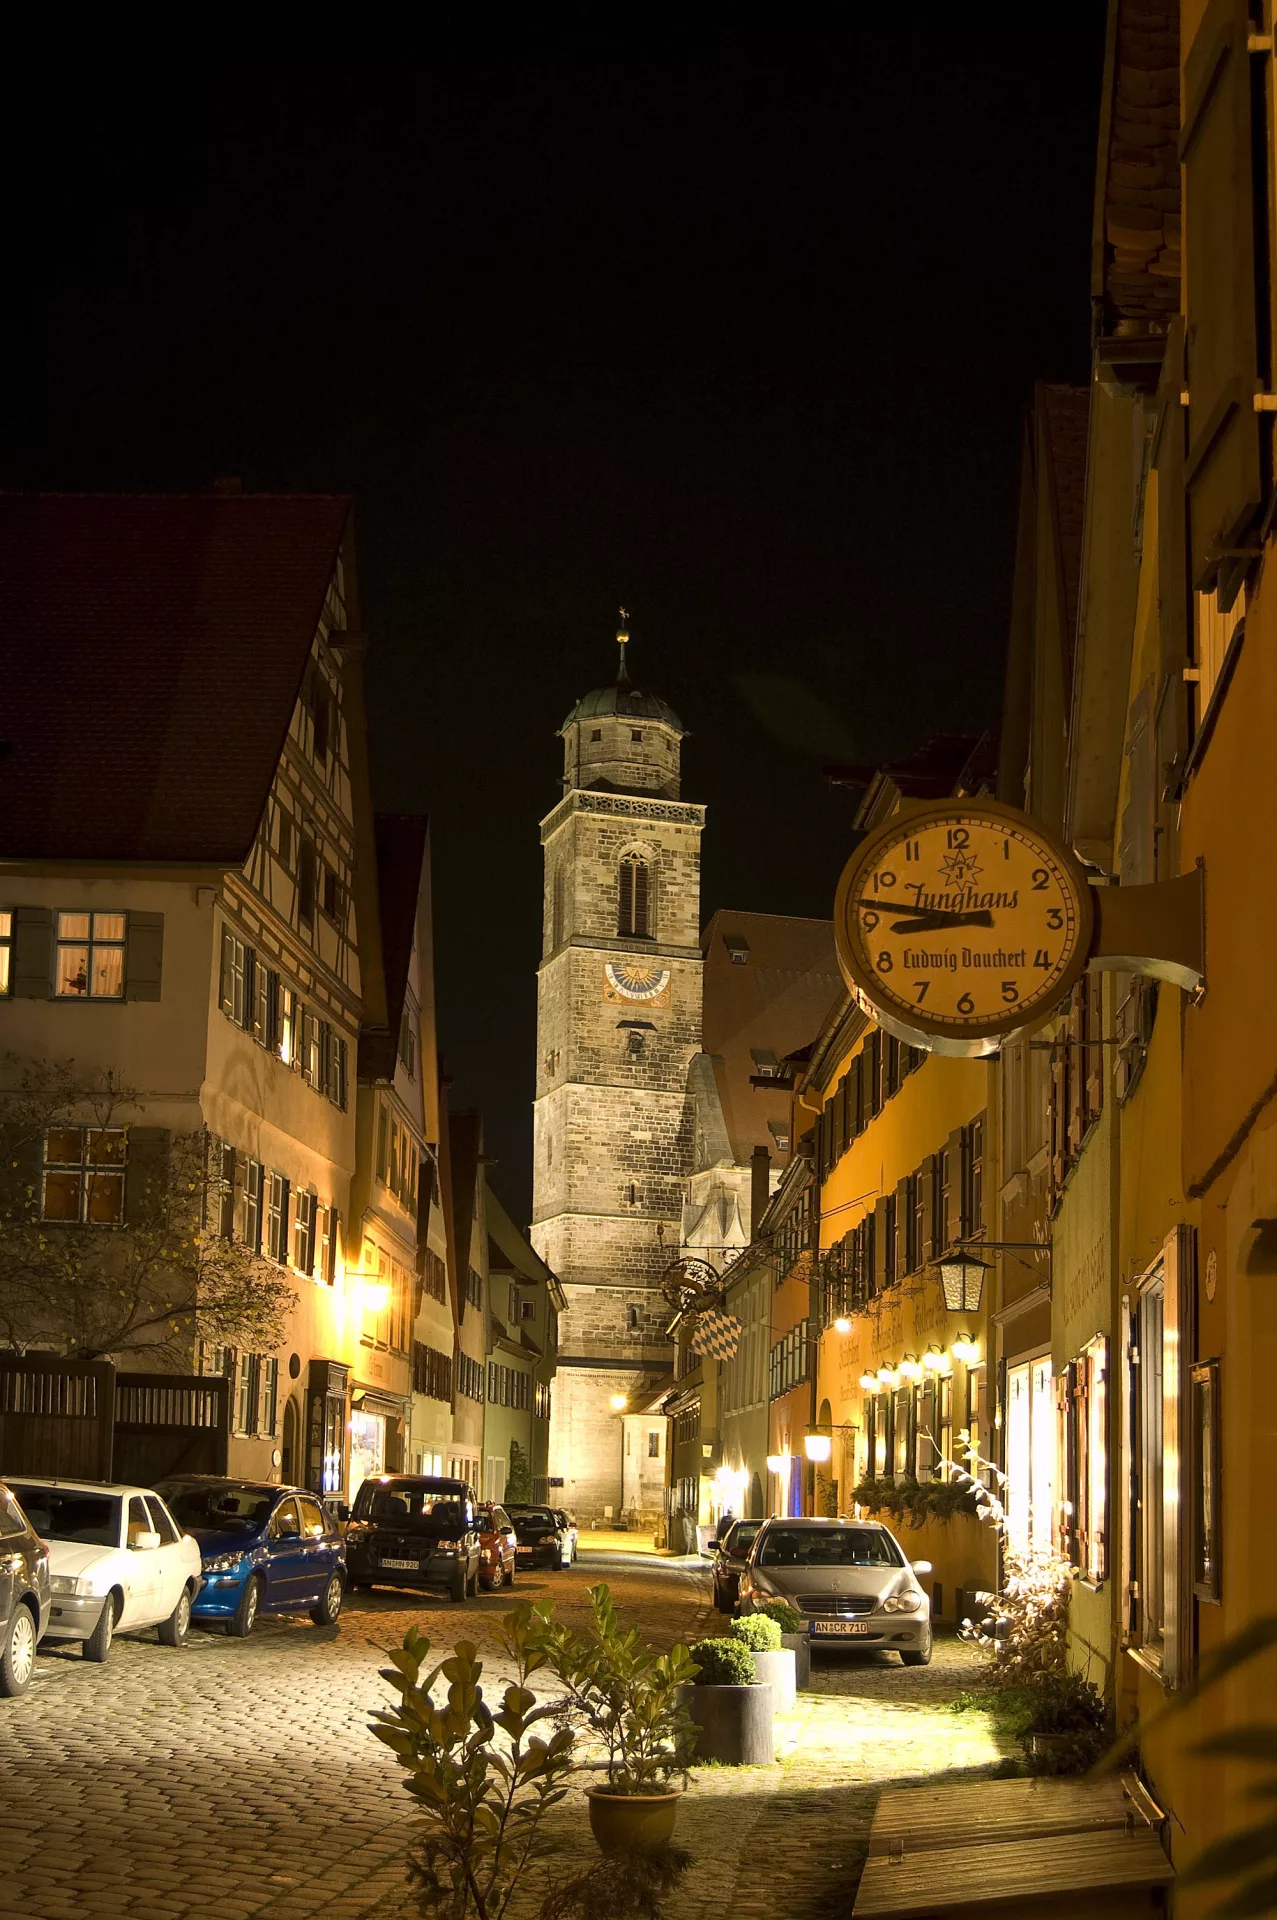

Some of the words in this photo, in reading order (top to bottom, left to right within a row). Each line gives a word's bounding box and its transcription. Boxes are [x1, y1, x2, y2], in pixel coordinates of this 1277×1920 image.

[947, 828, 969, 849] 12
[905, 840, 920, 861] 11
[1004, 839, 1009, 860] 1
[873, 871, 896, 893] 10
[956, 867, 964, 879] J
[1032, 869, 1049, 890] 2
[904, 883, 1018, 912] Junghans
[861, 911, 880, 932] 9
[1046, 908, 1064, 930] 3
[876, 951, 893, 973] 8
[903, 948, 957, 972] Ludwig
[1033, 950, 1053, 971] 4
[913, 982, 930, 1003] 7
[1002, 981, 1019, 1003] 5
[957, 993, 974, 1014] 6
[815, 1623, 828, 1632] AN
[834, 1623, 846, 1632] CR
[849, 1623, 866, 1632] 710
